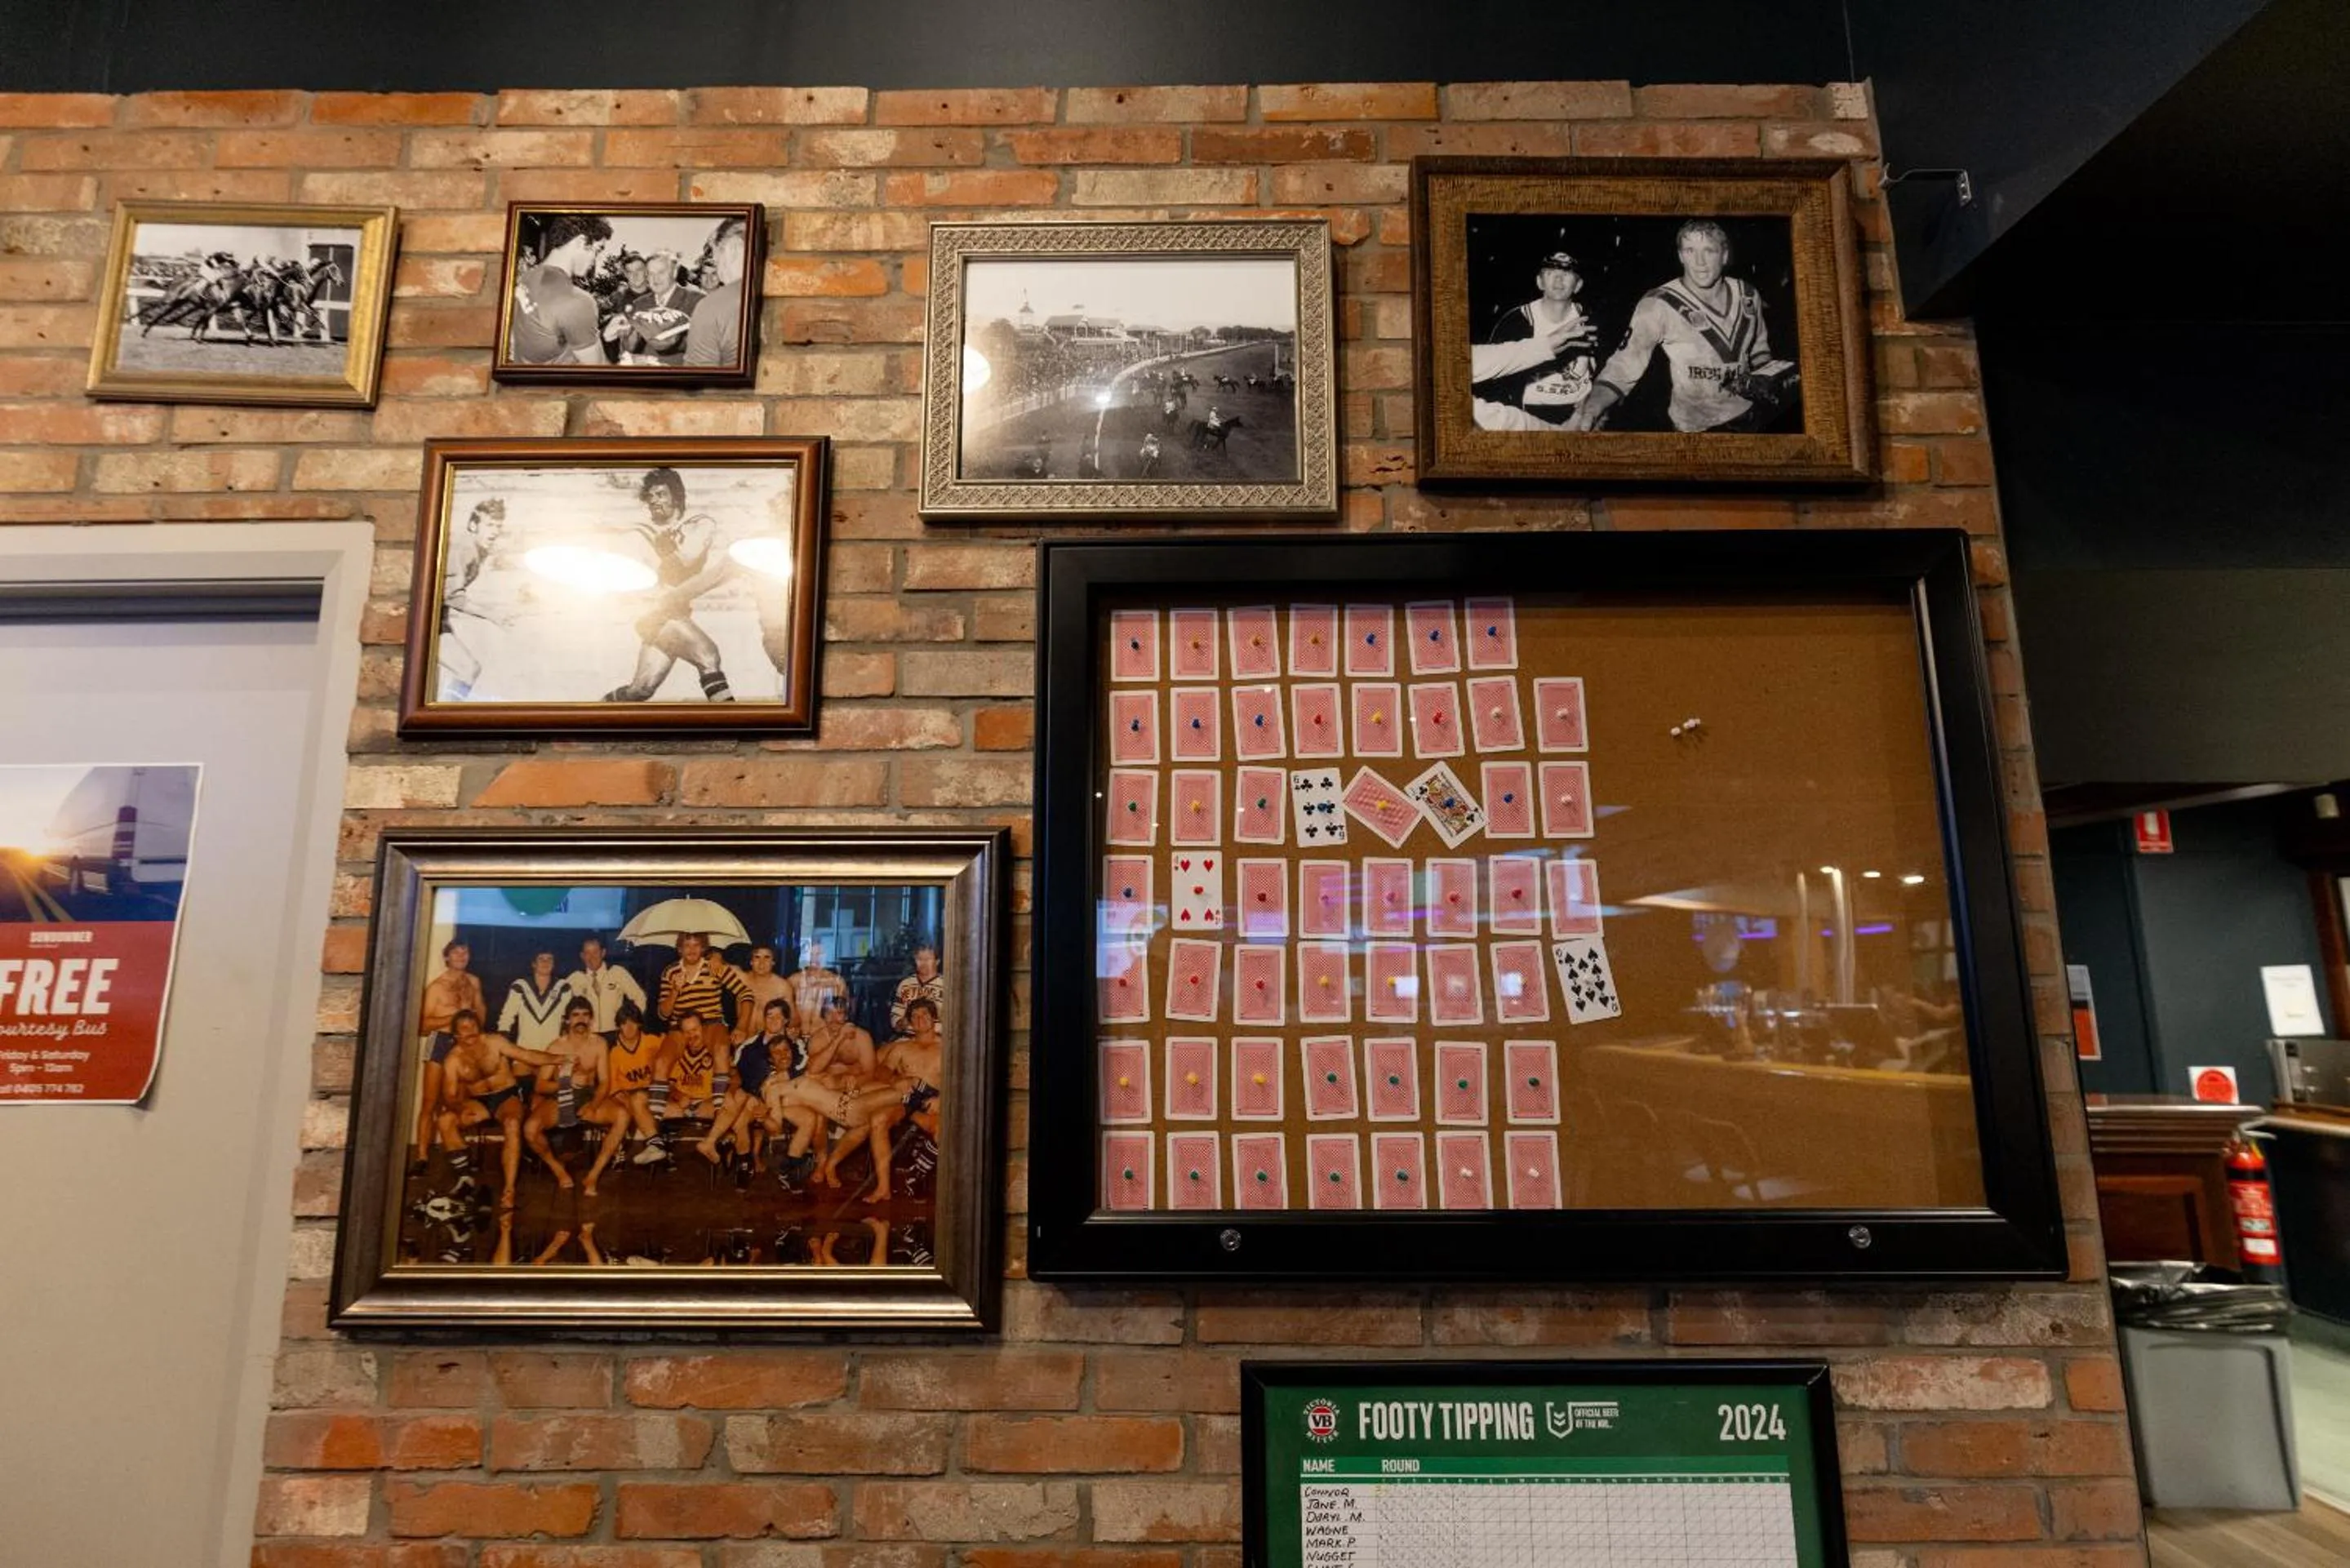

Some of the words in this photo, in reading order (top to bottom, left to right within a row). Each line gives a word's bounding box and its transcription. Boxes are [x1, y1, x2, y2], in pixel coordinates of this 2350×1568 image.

[0, 957, 120, 1016] FREE
[72, 1019, 108, 1036] Bus
[40, 1050, 91, 1062] Saturday
[1574, 1408, 1601, 1418] OFFICIAL
[1312, 1414, 1333, 1428] VB
[1358, 1401, 1438, 1441] FOOTY
[1438, 1401, 1535, 1441] TIPPING
[1717, 1403, 1787, 1441] 2024
[1303, 1459, 1335, 1472] NAME
[1381, 1459, 1420, 1472] ROUND
